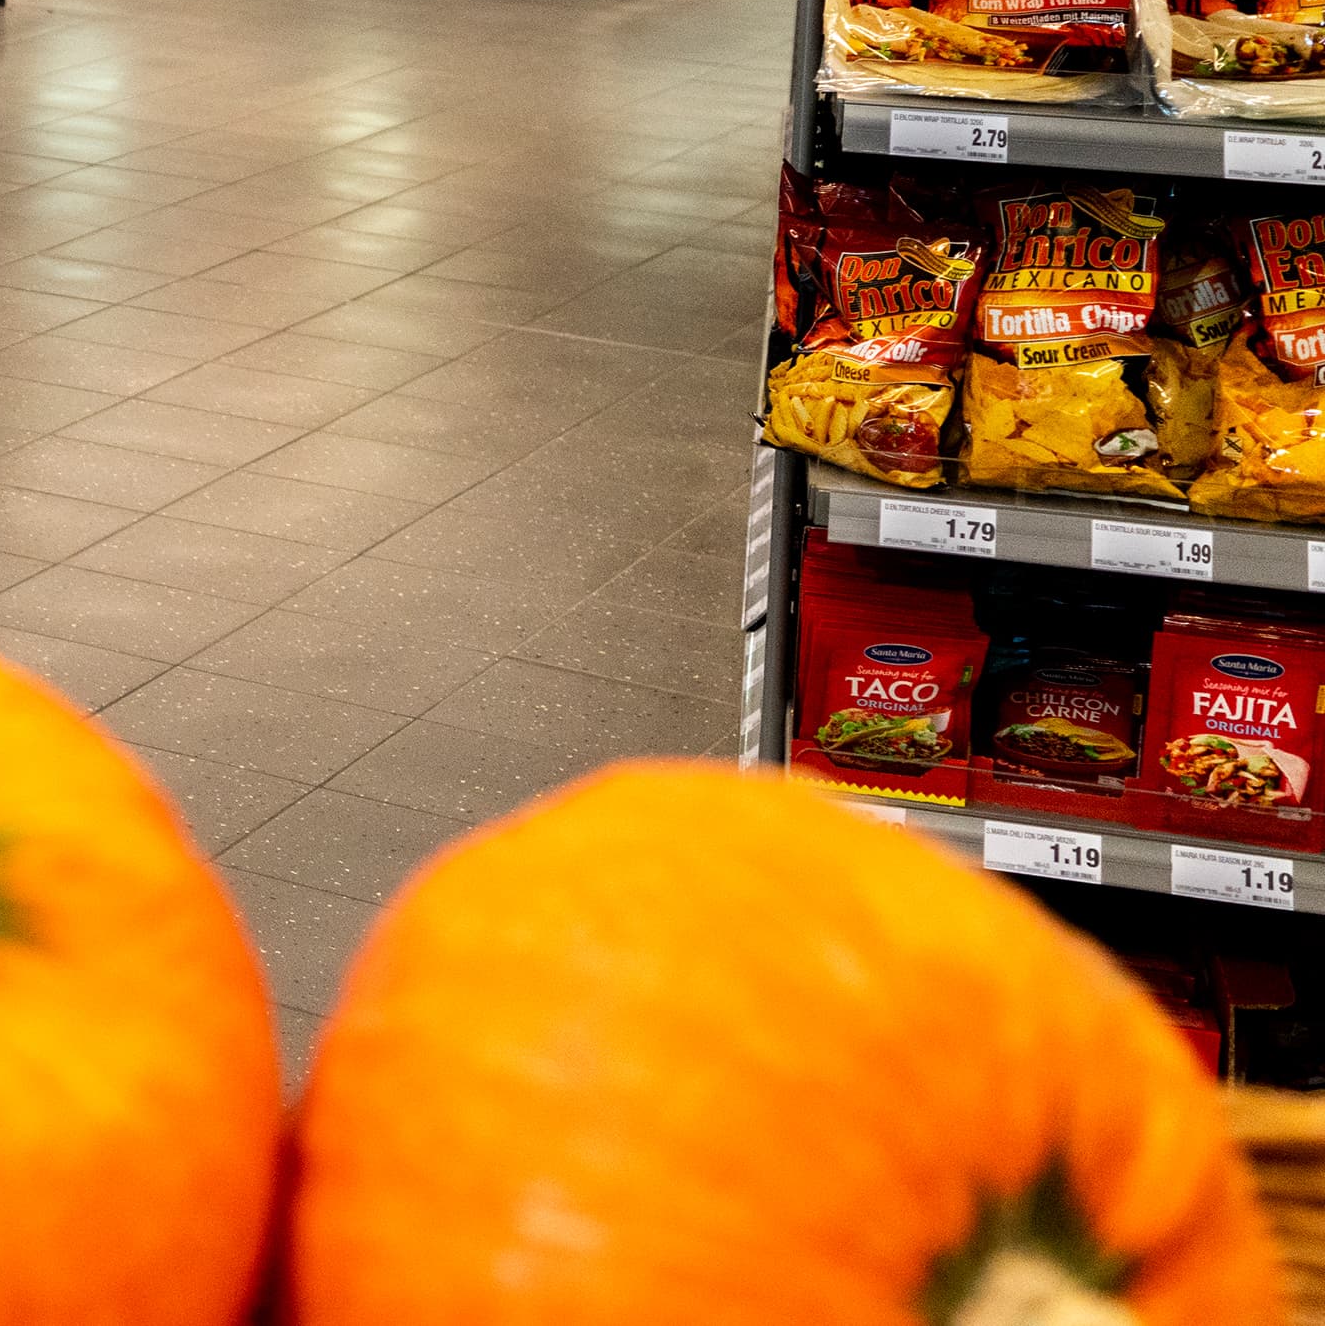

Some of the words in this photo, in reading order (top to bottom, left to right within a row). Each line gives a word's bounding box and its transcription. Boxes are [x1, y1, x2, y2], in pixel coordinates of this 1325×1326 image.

[992, 16, 998, 24] 8
[1001, 15, 1061, 25] Weizenfladen
[1062, 12, 1078, 21] mit
[941, 117, 969, 125] TORTILLAS
[972, 128, 1007, 148] 2.79
[1257, 137, 1286, 146] TORTILLAS
[1005, 202, 1073, 233] Don
[1001, 227, 1141, 271] Enrico
[841, 256, 901, 283] Don
[988, 270, 1144, 290] MEXICANO
[840, 274, 954, 320] Enrico
[989, 308, 1071, 336] Tortilla
[1080, 305, 1146, 333] Chips
[1023, 346, 1060, 365] Sour
[1063, 342, 1112, 362] Cream
[835, 361, 871, 381] Cheese
[930, 508, 950, 516] CHEESE
[946, 519, 995, 542] 1.79
[1135, 527, 1151, 535] SOUR
[1152, 529, 1172, 538] CREAM
[1176, 541, 1211, 564] 1.99
[871, 647, 898, 658] Santa
[899, 650, 927, 660] Maria
[856, 665, 900, 680] Seasoning
[902, 671, 920, 679] mix
[920, 670, 937, 681] for
[1217, 658, 1246, 669] Santa
[1248, 663, 1277, 674] Maria
[844, 676, 940, 703] TACO
[1203, 678, 1250, 696] Seasoning
[1251, 686, 1271, 695] mix
[1272, 687, 1288, 698] for
[856, 698, 926, 713] ORIGINAL
[1010, 691, 1066, 706] CHILI
[1070, 697, 1120, 716] CON
[1192, 691, 1297, 729] FAJITA
[1026, 705, 1102, 723] CARNE
[1205, 719, 1281, 739] ORIGINAL
[1049, 843, 1099, 868] 1.19
[1241, 867, 1293, 893] 1.19
